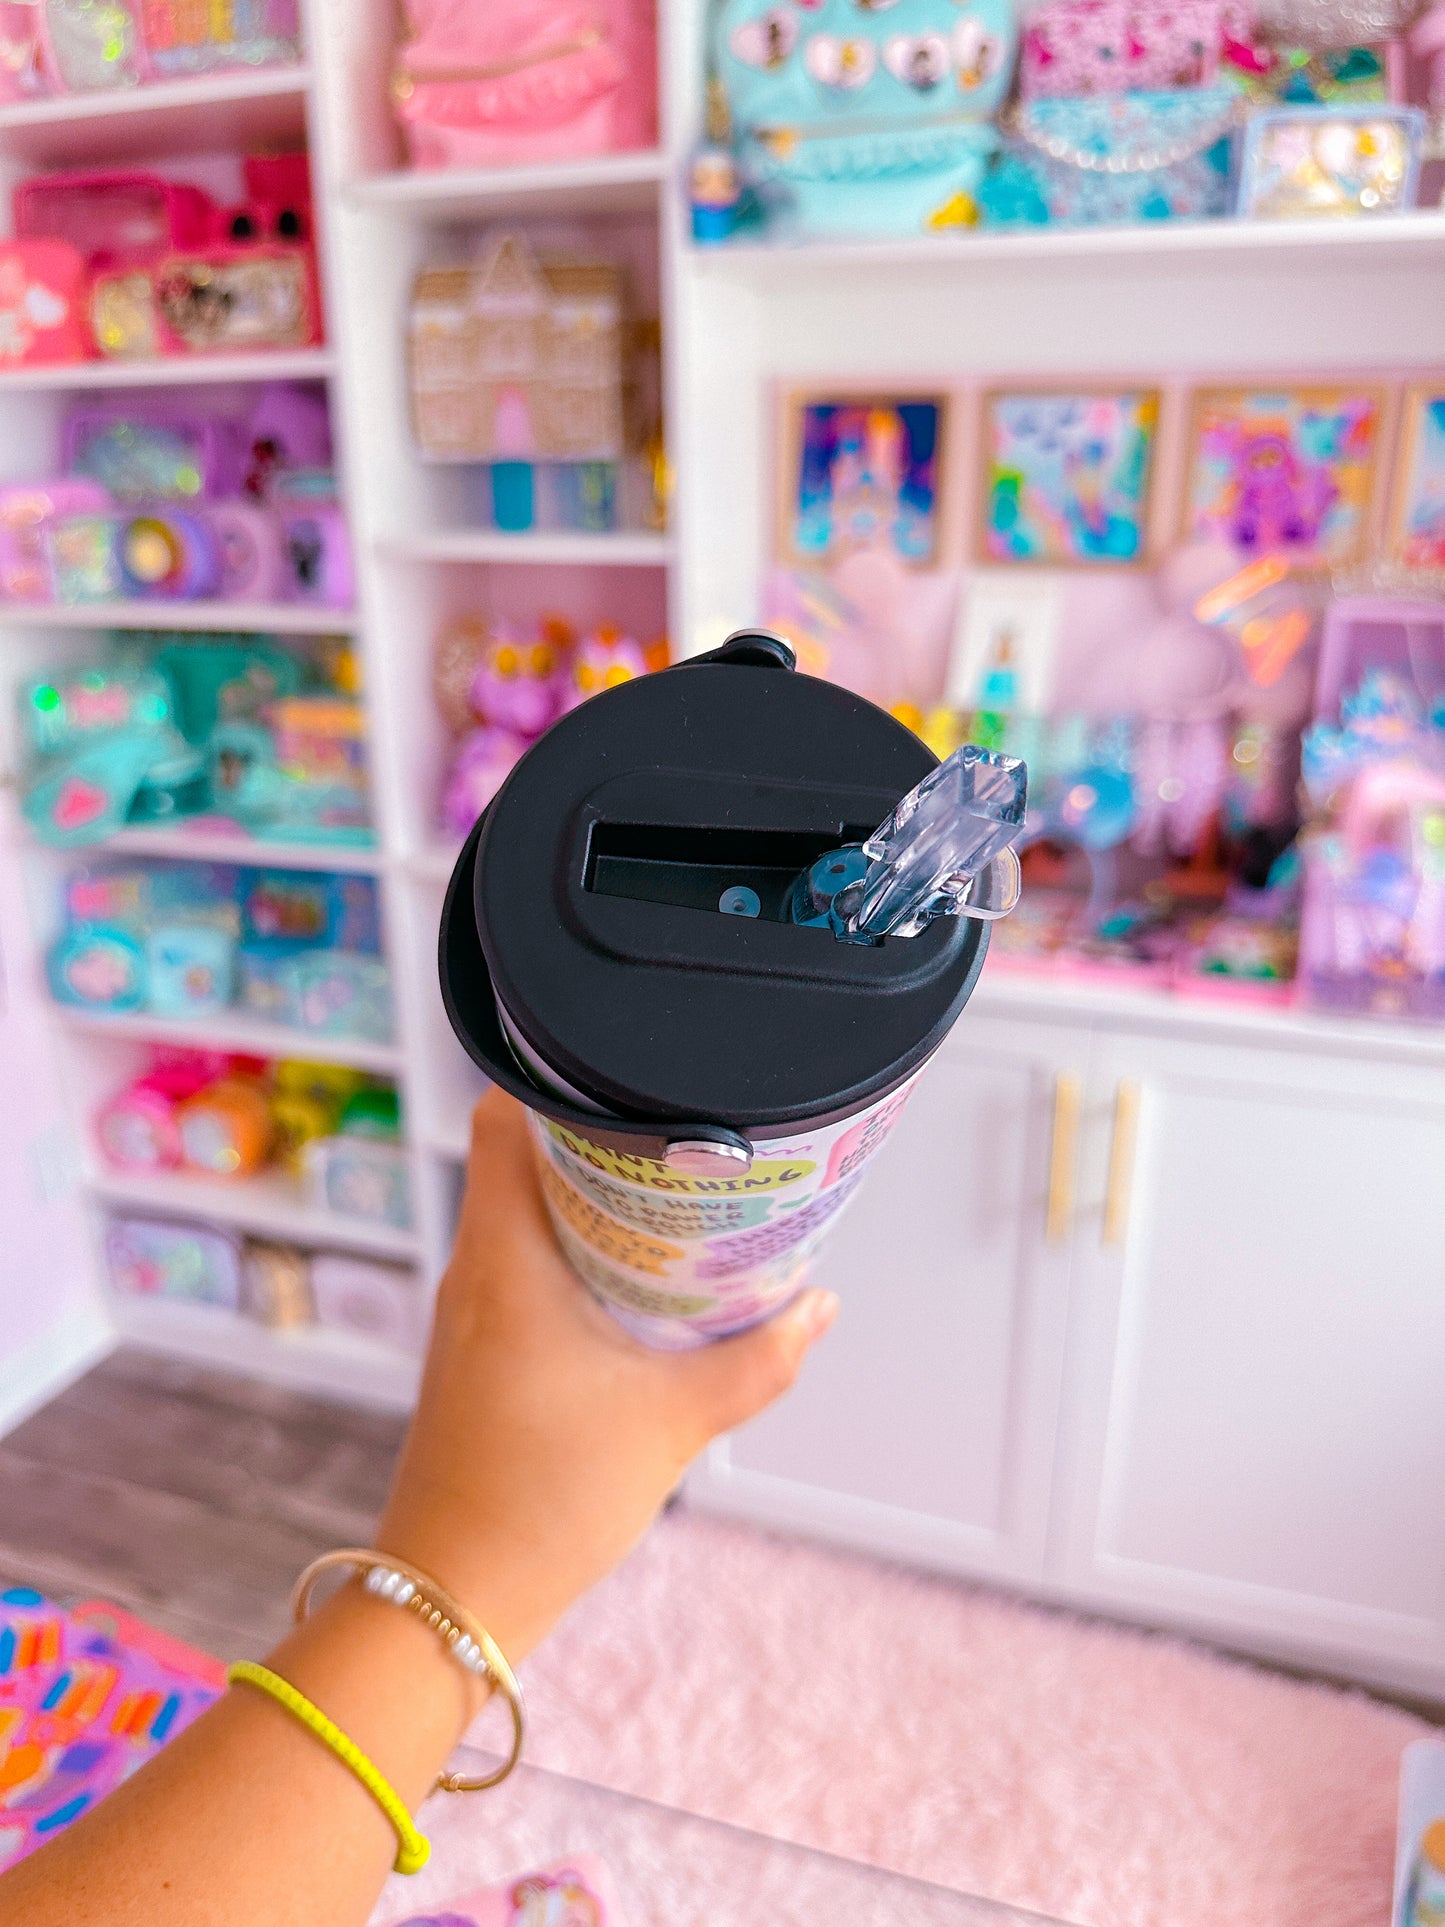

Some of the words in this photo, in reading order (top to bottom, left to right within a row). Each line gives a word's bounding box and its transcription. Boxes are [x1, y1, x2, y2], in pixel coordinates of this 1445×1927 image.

[560, 1131, 606, 1170] DO
[614, 1164, 802, 1192] NOTHING
[577, 1166, 647, 1204] DON'T
[664, 1199, 744, 1211] HAVE
[592, 1187, 633, 1211] TO
[640, 1207, 745, 1221] POWER
